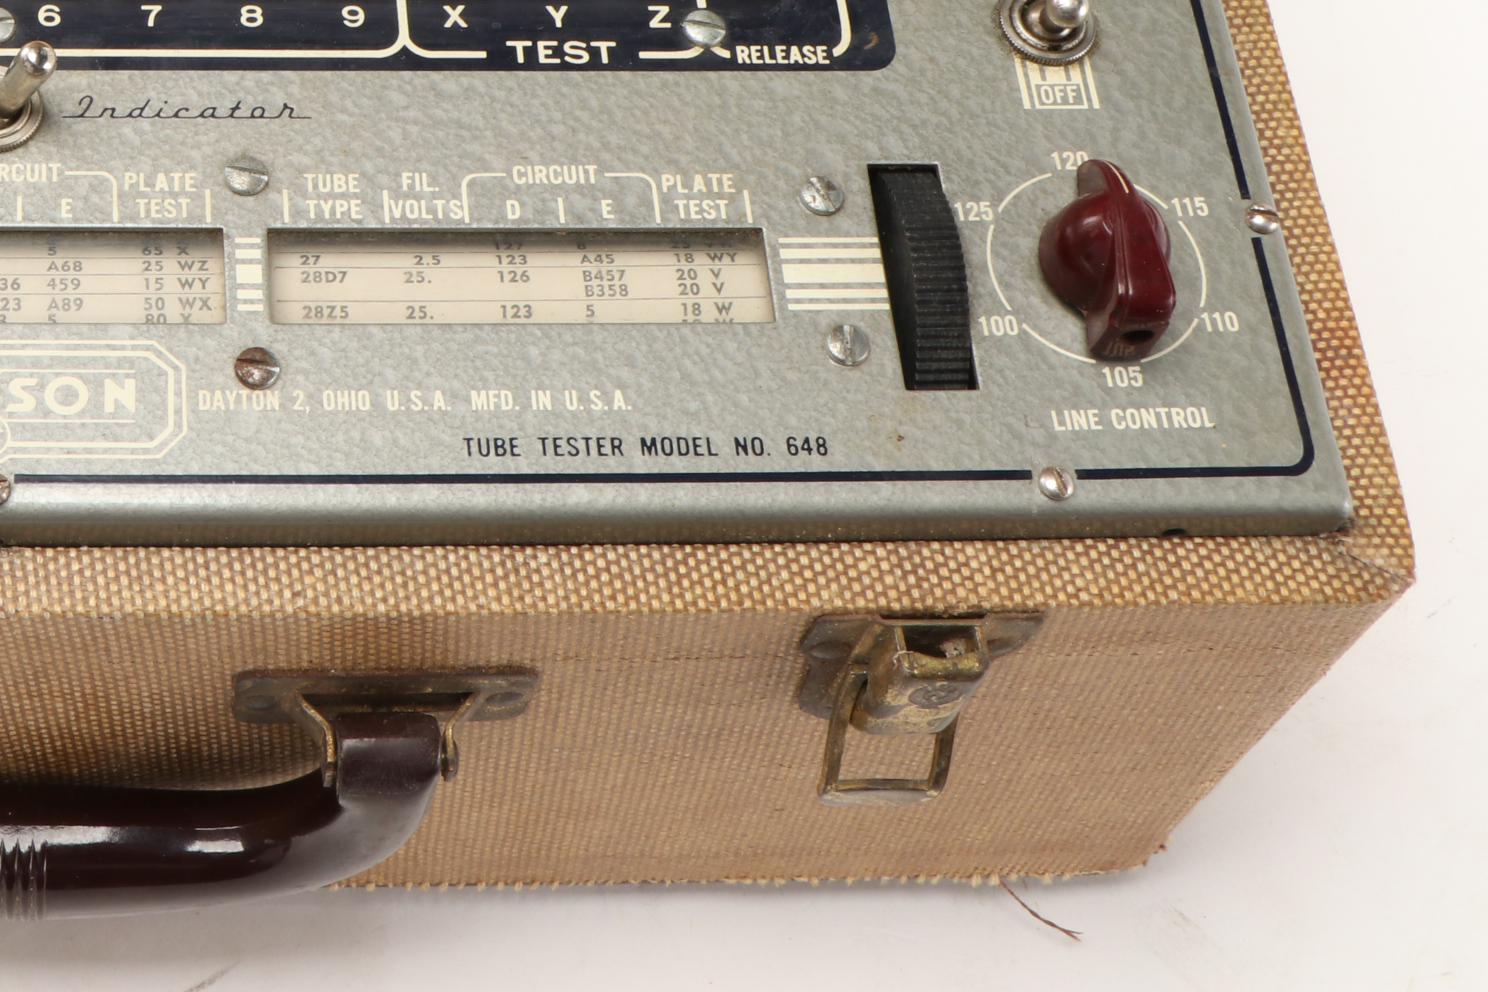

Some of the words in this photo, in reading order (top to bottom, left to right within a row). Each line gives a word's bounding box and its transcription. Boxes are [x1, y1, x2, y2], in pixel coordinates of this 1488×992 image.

[37, 4, 61, 26] 6
[139, 5, 163, 27] 7
[239, 4, 264, 28] 8
[341, 5, 366, 28] 9
[443, 5, 469, 28] X
[545, 5, 569, 28] Y
[648, 5, 672, 28] Z
[506, 41, 617, 65] TEST
[736, 45, 830, 65] RELEASE
[1040, 86, 1078, 104] OFF
[62, 95, 311, 119] Indicator
[124, 173, 197, 192] PLATE
[136, 199, 190, 218] TEST
[955, 201, 993, 222] 125
[1171, 197, 1209, 217] 115
[46, 260, 83, 272] A68
[142, 260, 164, 272] 25
[176, 260, 209, 272] WZ
[300, 255, 321, 265] 27
[414, 255, 441, 266] 2.5
[496, 255, 528, 265] 123
[580, 254, 615, 265] A45
[674, 253, 695, 264] 18
[706, 252, 738, 263] WY
[46, 278, 81, 291] 459
[143, 278, 164, 291] 15
[176, 277, 211, 291] WY
[302, 306, 349, 320] 28Z5
[501, 305, 533, 319] 123
[586, 304, 595, 318] 5
[681, 302, 702, 316] 18
[978, 315, 1019, 336] 100
[1201, 312, 1240, 332] 110
[1102, 366, 1143, 387] 105
[199, 391, 279, 410] DAYTON
[292, 391, 310, 414] 2,
[322, 390, 370, 411] OHIO
[470, 390, 520, 411] MFD.
[530, 390, 551, 411] IN
[1051, 410, 1102, 431] LINE
[1112, 406, 1215, 429] CONTROL
[462, 436, 521, 457] TUBE
[537, 436, 623, 457] TESTER
[640, 436, 718, 457] MODEL
[734, 436, 771, 456] NO.
[786, 436, 829, 456] 648
